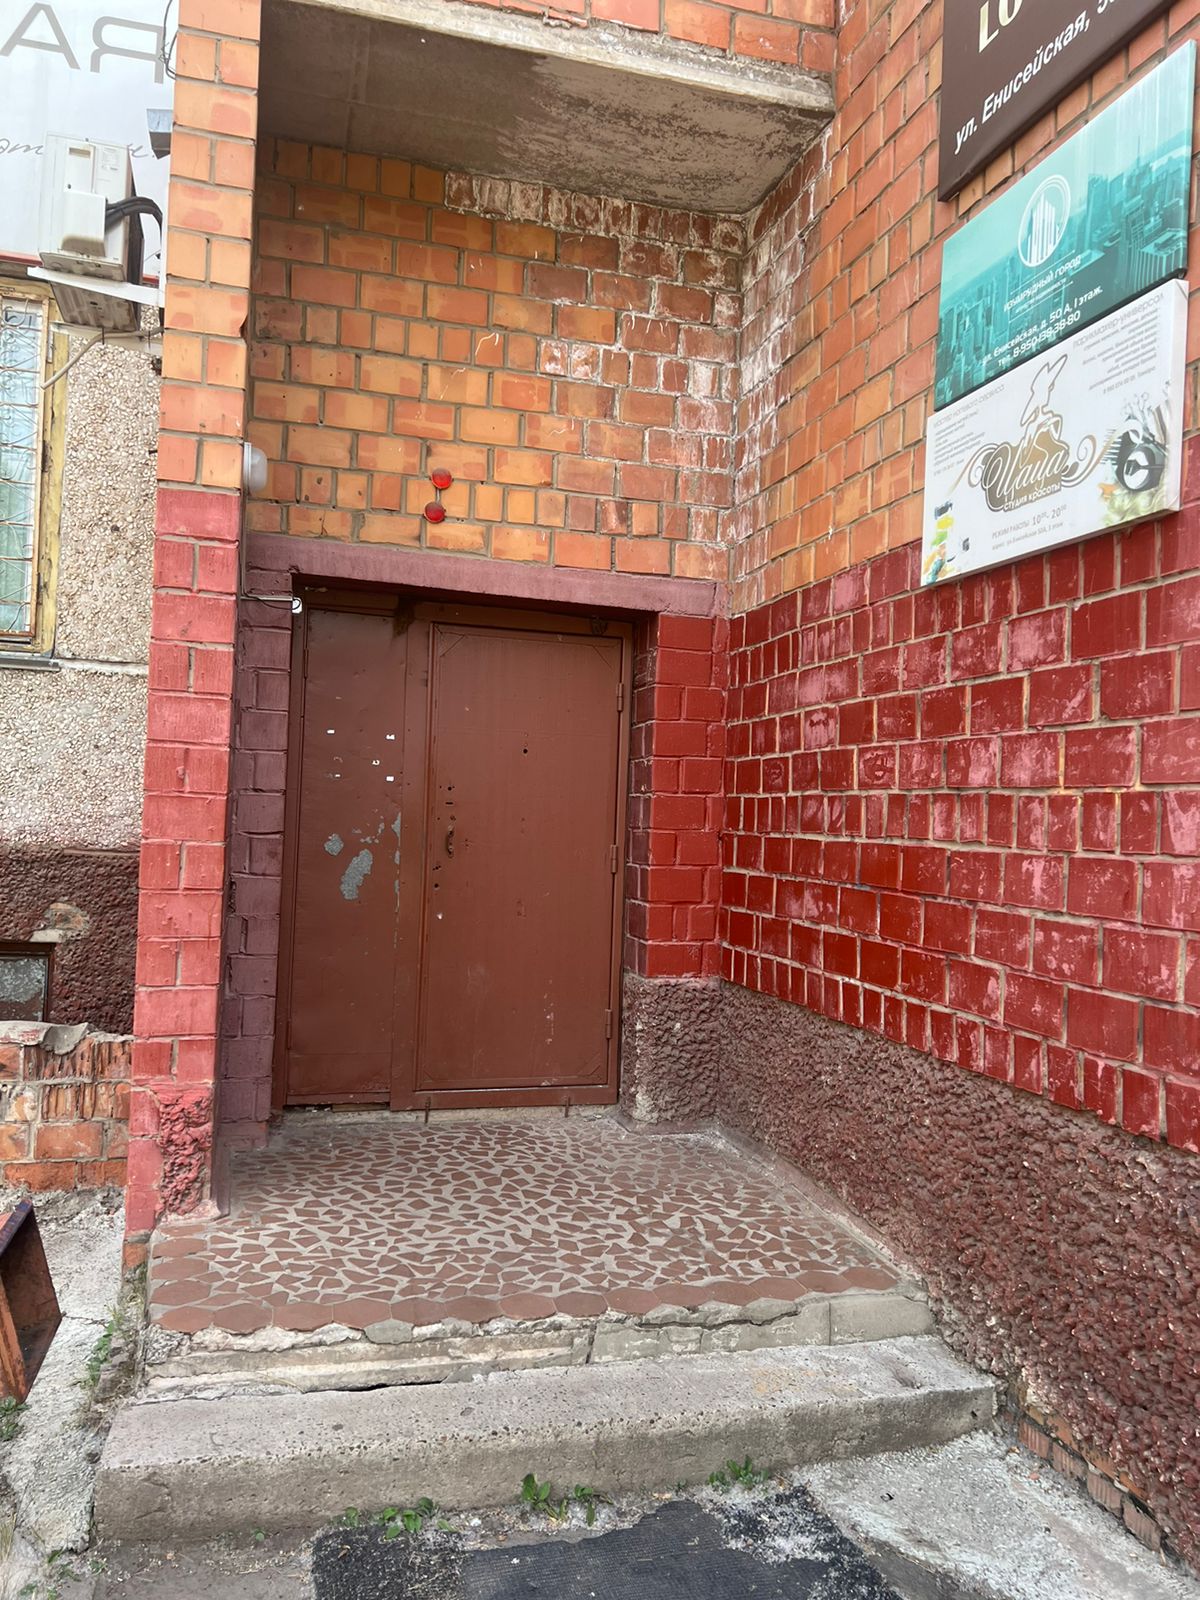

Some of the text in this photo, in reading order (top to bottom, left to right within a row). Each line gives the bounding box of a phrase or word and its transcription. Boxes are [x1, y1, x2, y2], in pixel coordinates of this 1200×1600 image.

[954, 10, 1091, 155] ул. Енисейская,
[1003, 254, 1082, 312] ИЗУМРУДНЫЙ ГОРОД
[1049, 310, 1062, 323] 50
